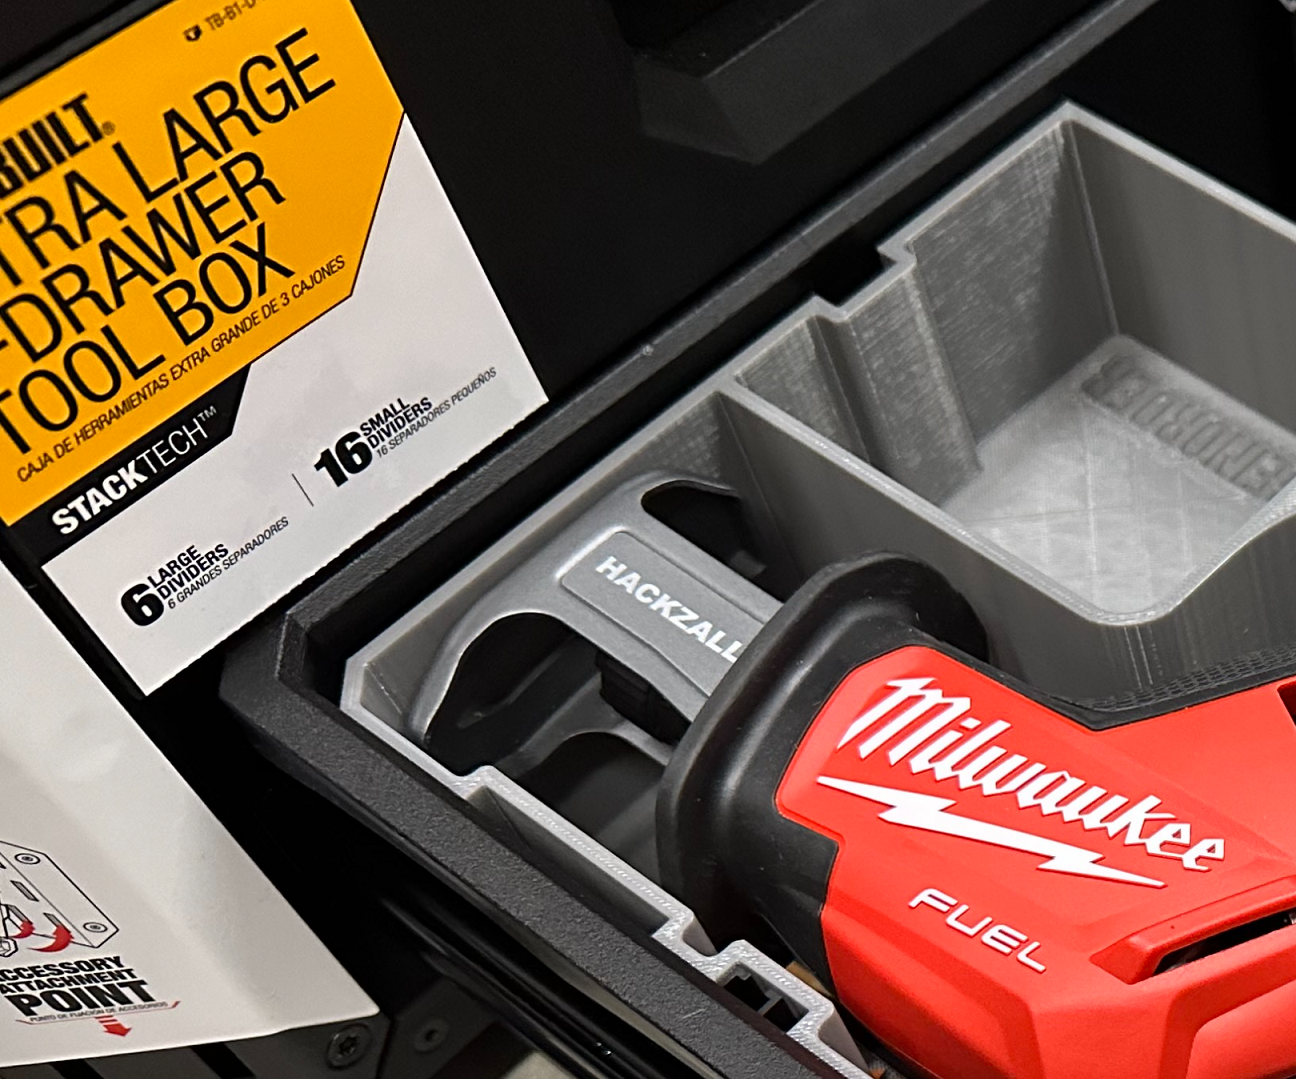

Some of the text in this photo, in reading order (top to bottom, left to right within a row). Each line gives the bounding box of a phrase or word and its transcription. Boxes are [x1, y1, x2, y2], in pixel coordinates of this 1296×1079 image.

[112, 27, 336, 204] LARGE
[153, 222, 295, 346] BOX
[17, 255, 346, 482] CAJA DE HERRAMIENTAS EXTRA GRANDE DE 3 CAJONES
[376, 367, 497, 459] 16 SEPARADORES PEQUEÑOS
[314, 397, 410, 488] 16 SMALL
[367, 397, 433, 449] DIVIDERS
[120, 545, 202, 626] 6 LARGE
[157, 543, 229, 601] DIVIDERS
[167, 516, 289, 610] 6 GRANDES SEPARADORES
[595, 555, 744, 664] HACKZALL
[837, 676, 1226, 873] Milwaukee
[908, 887, 1047, 974] FUEL
[0, 968, 138, 994] ATTACHMENT
[4, 979, 157, 1017] POINT
